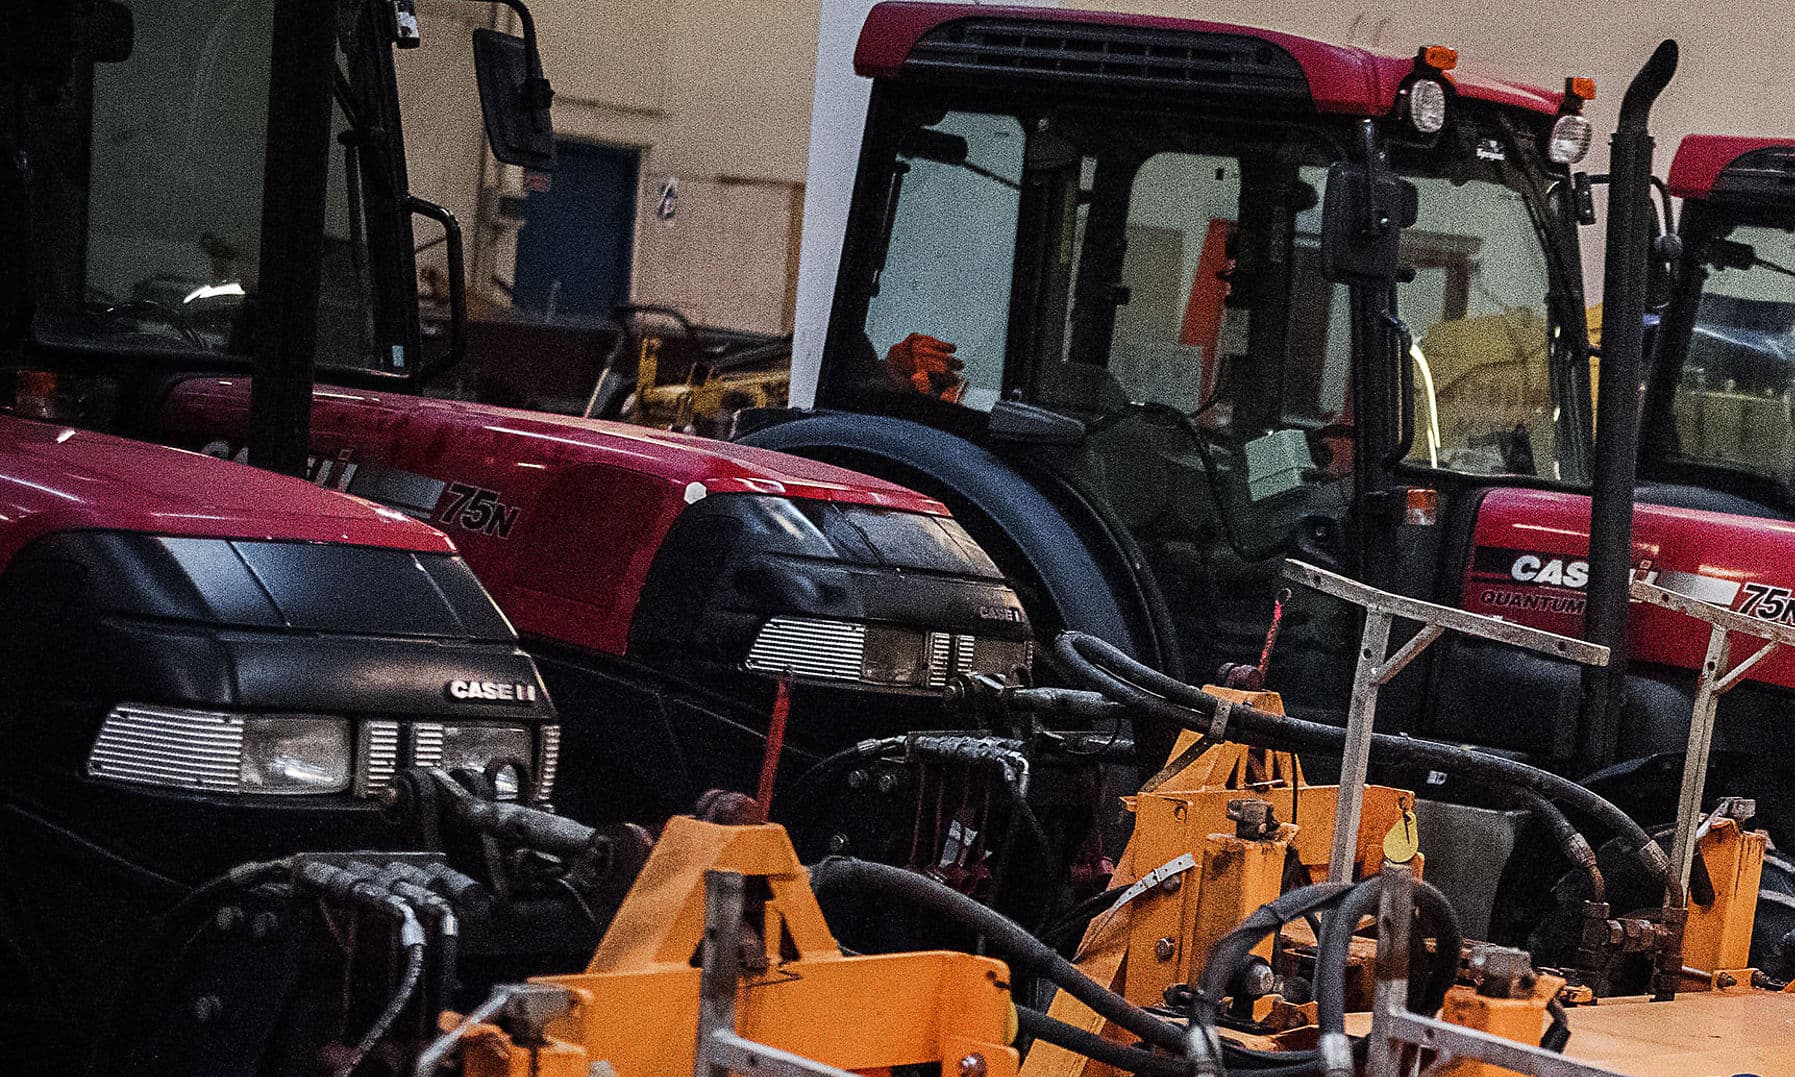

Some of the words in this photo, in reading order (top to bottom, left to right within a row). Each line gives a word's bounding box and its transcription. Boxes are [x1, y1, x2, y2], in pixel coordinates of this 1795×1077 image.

[439, 481, 521, 540] 75N
[1511, 555, 1590, 588] CAS
[980, 606, 1013, 621] CASE
[1481, 589, 1587, 616] QUANTUM
[450, 681, 514, 700] CASE
